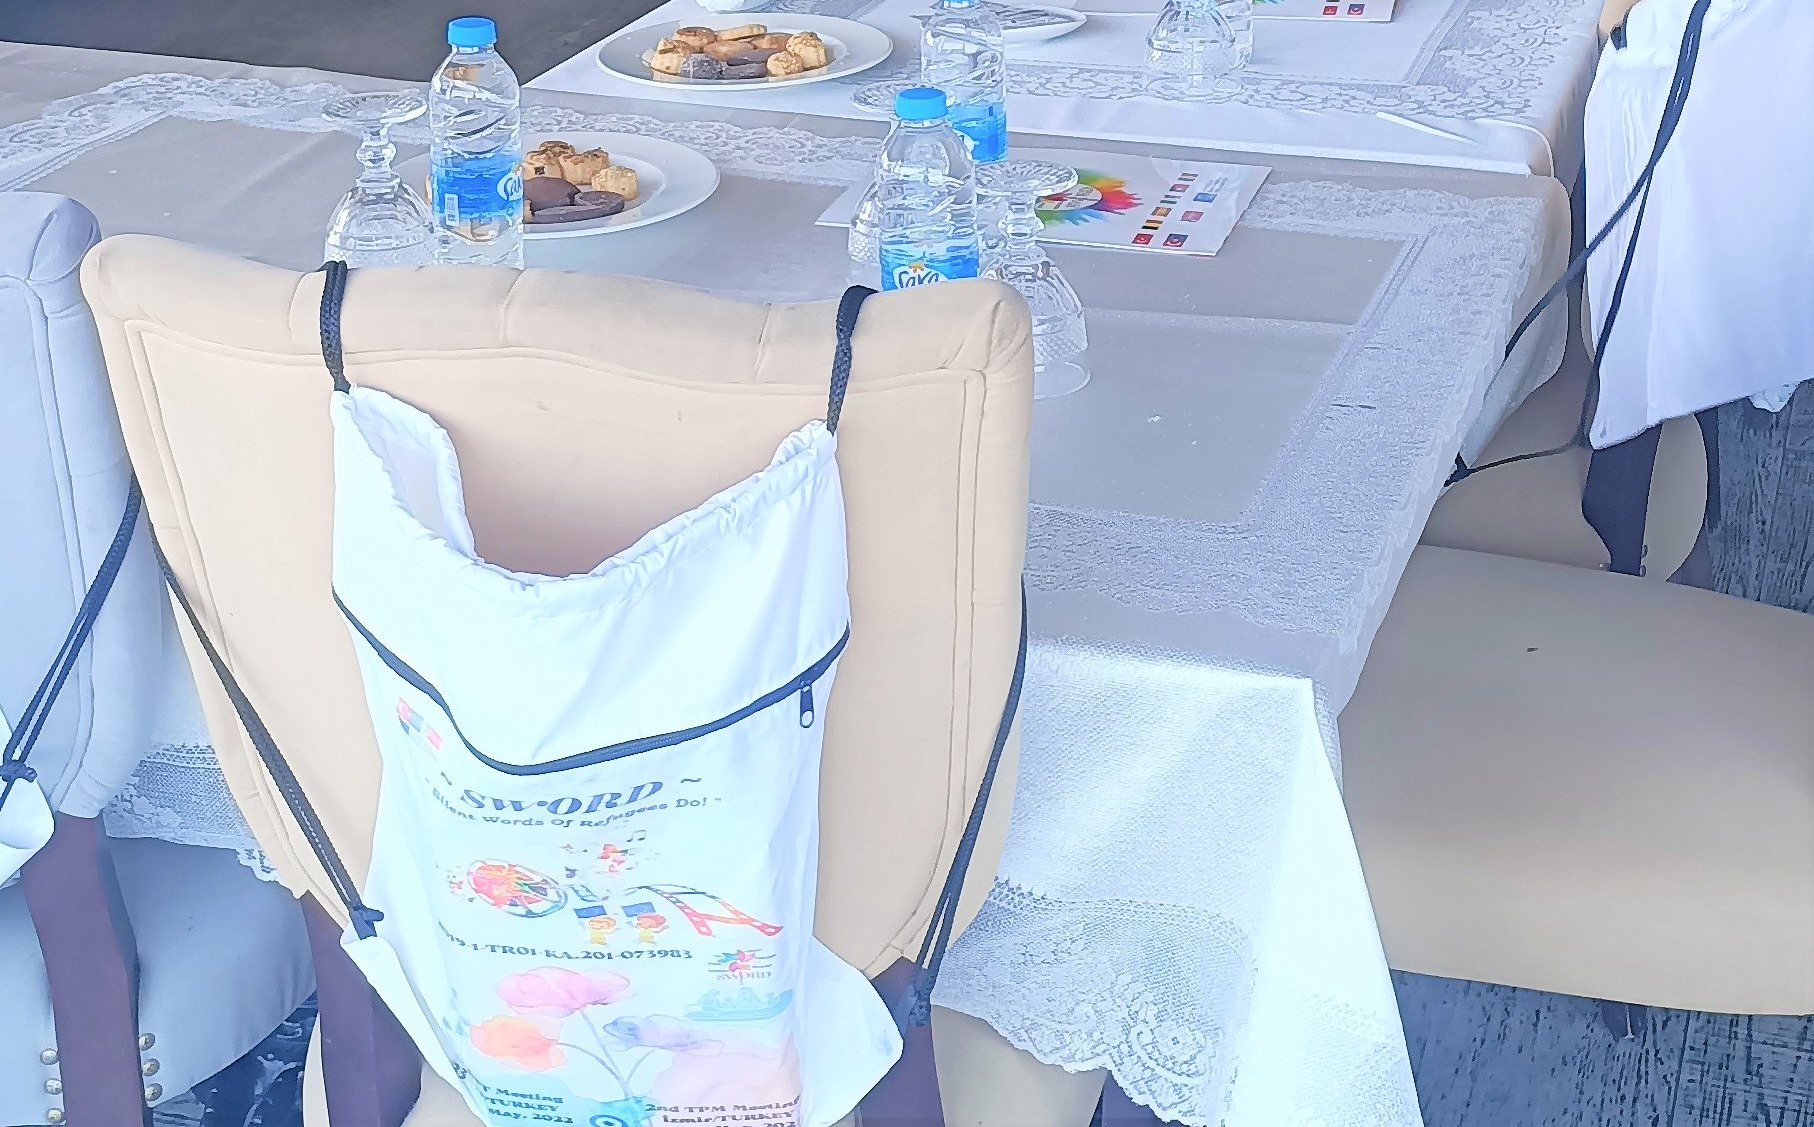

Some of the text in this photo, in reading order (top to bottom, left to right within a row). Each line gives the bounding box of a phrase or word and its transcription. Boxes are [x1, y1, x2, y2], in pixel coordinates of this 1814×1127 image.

[482, 816, 545, 826] Words
[550, 818, 575, 828] Of
[675, 796, 708, 808] Do!
